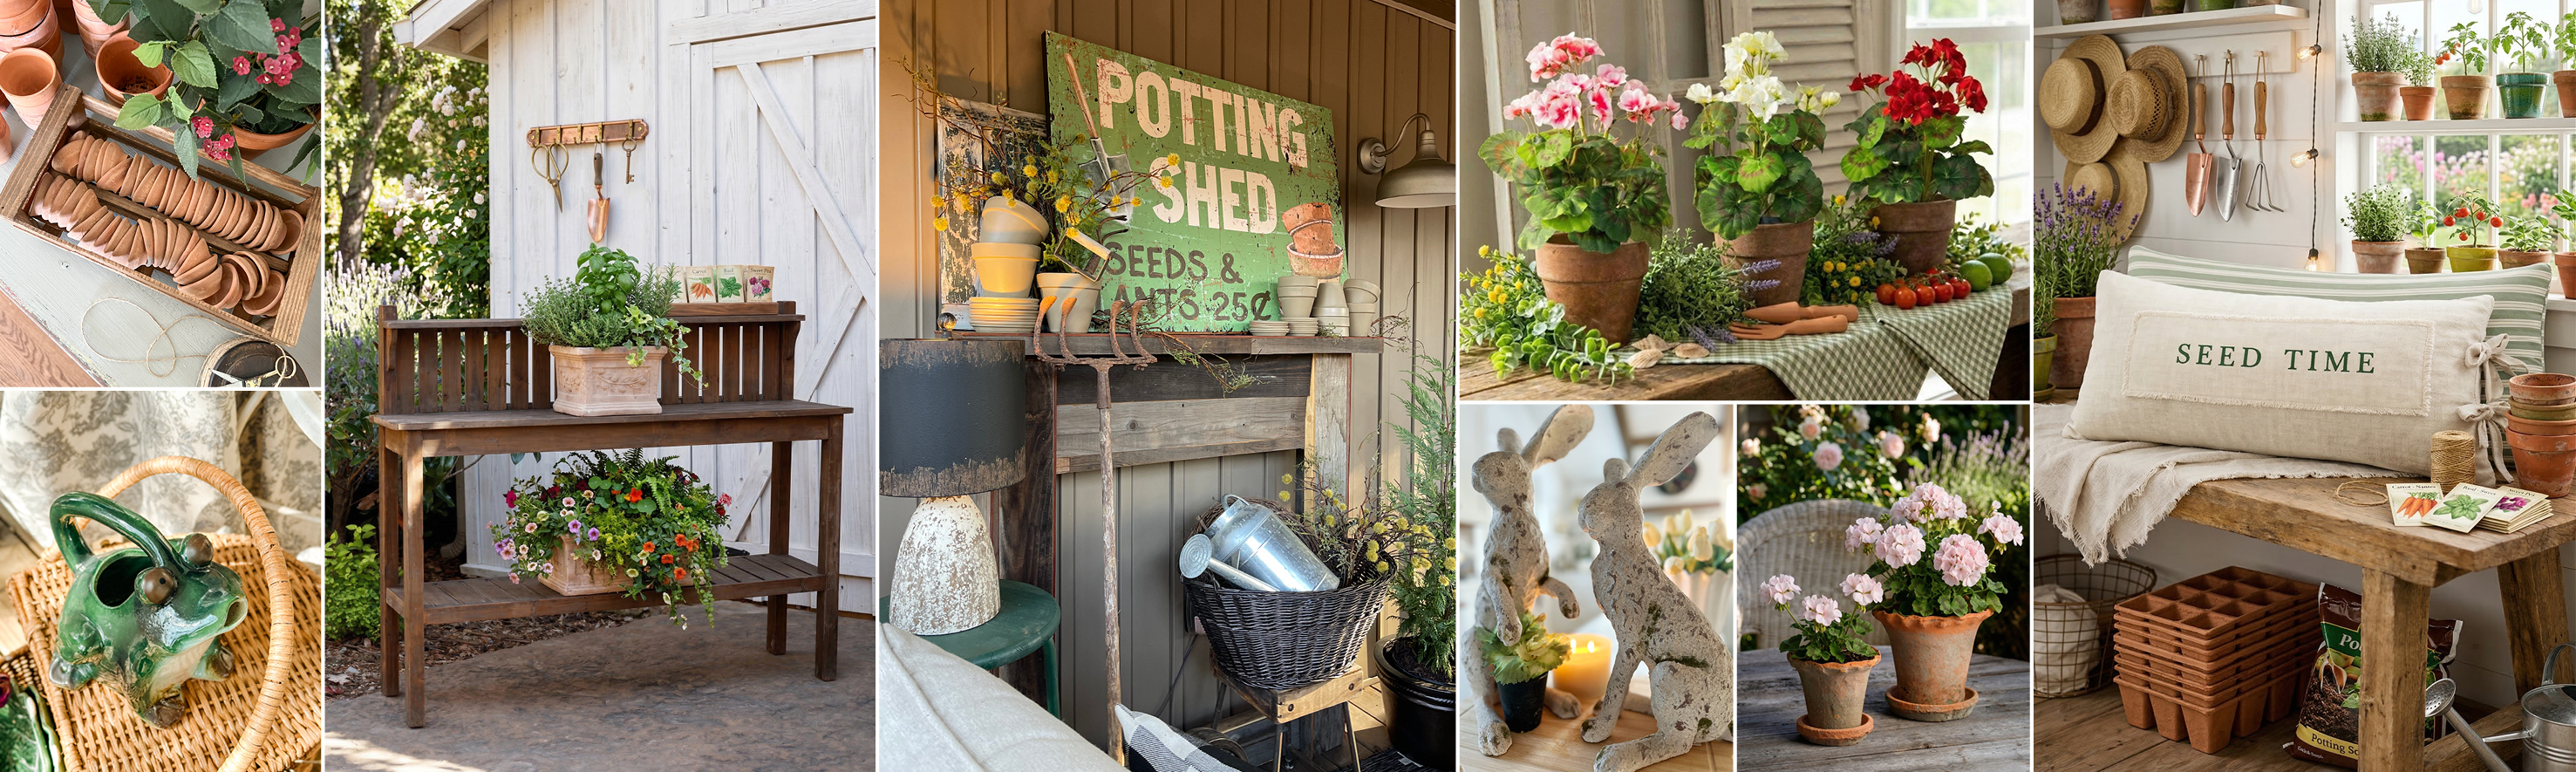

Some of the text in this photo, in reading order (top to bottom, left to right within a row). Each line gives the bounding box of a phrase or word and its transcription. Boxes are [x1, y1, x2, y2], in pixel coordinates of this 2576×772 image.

[1096, 58, 1309, 168] POTTING
[1149, 157, 1278, 235] SHED
[1104, 242, 1244, 284] SEEDS &
[1094, 284, 1272, 322] LANTS 25¢
[2176, 343, 2375, 374] SEED TIME
[2339, 633, 2361, 652] Po
[2311, 733, 2346, 755] Potting
[2348, 745, 2359, 756] So
